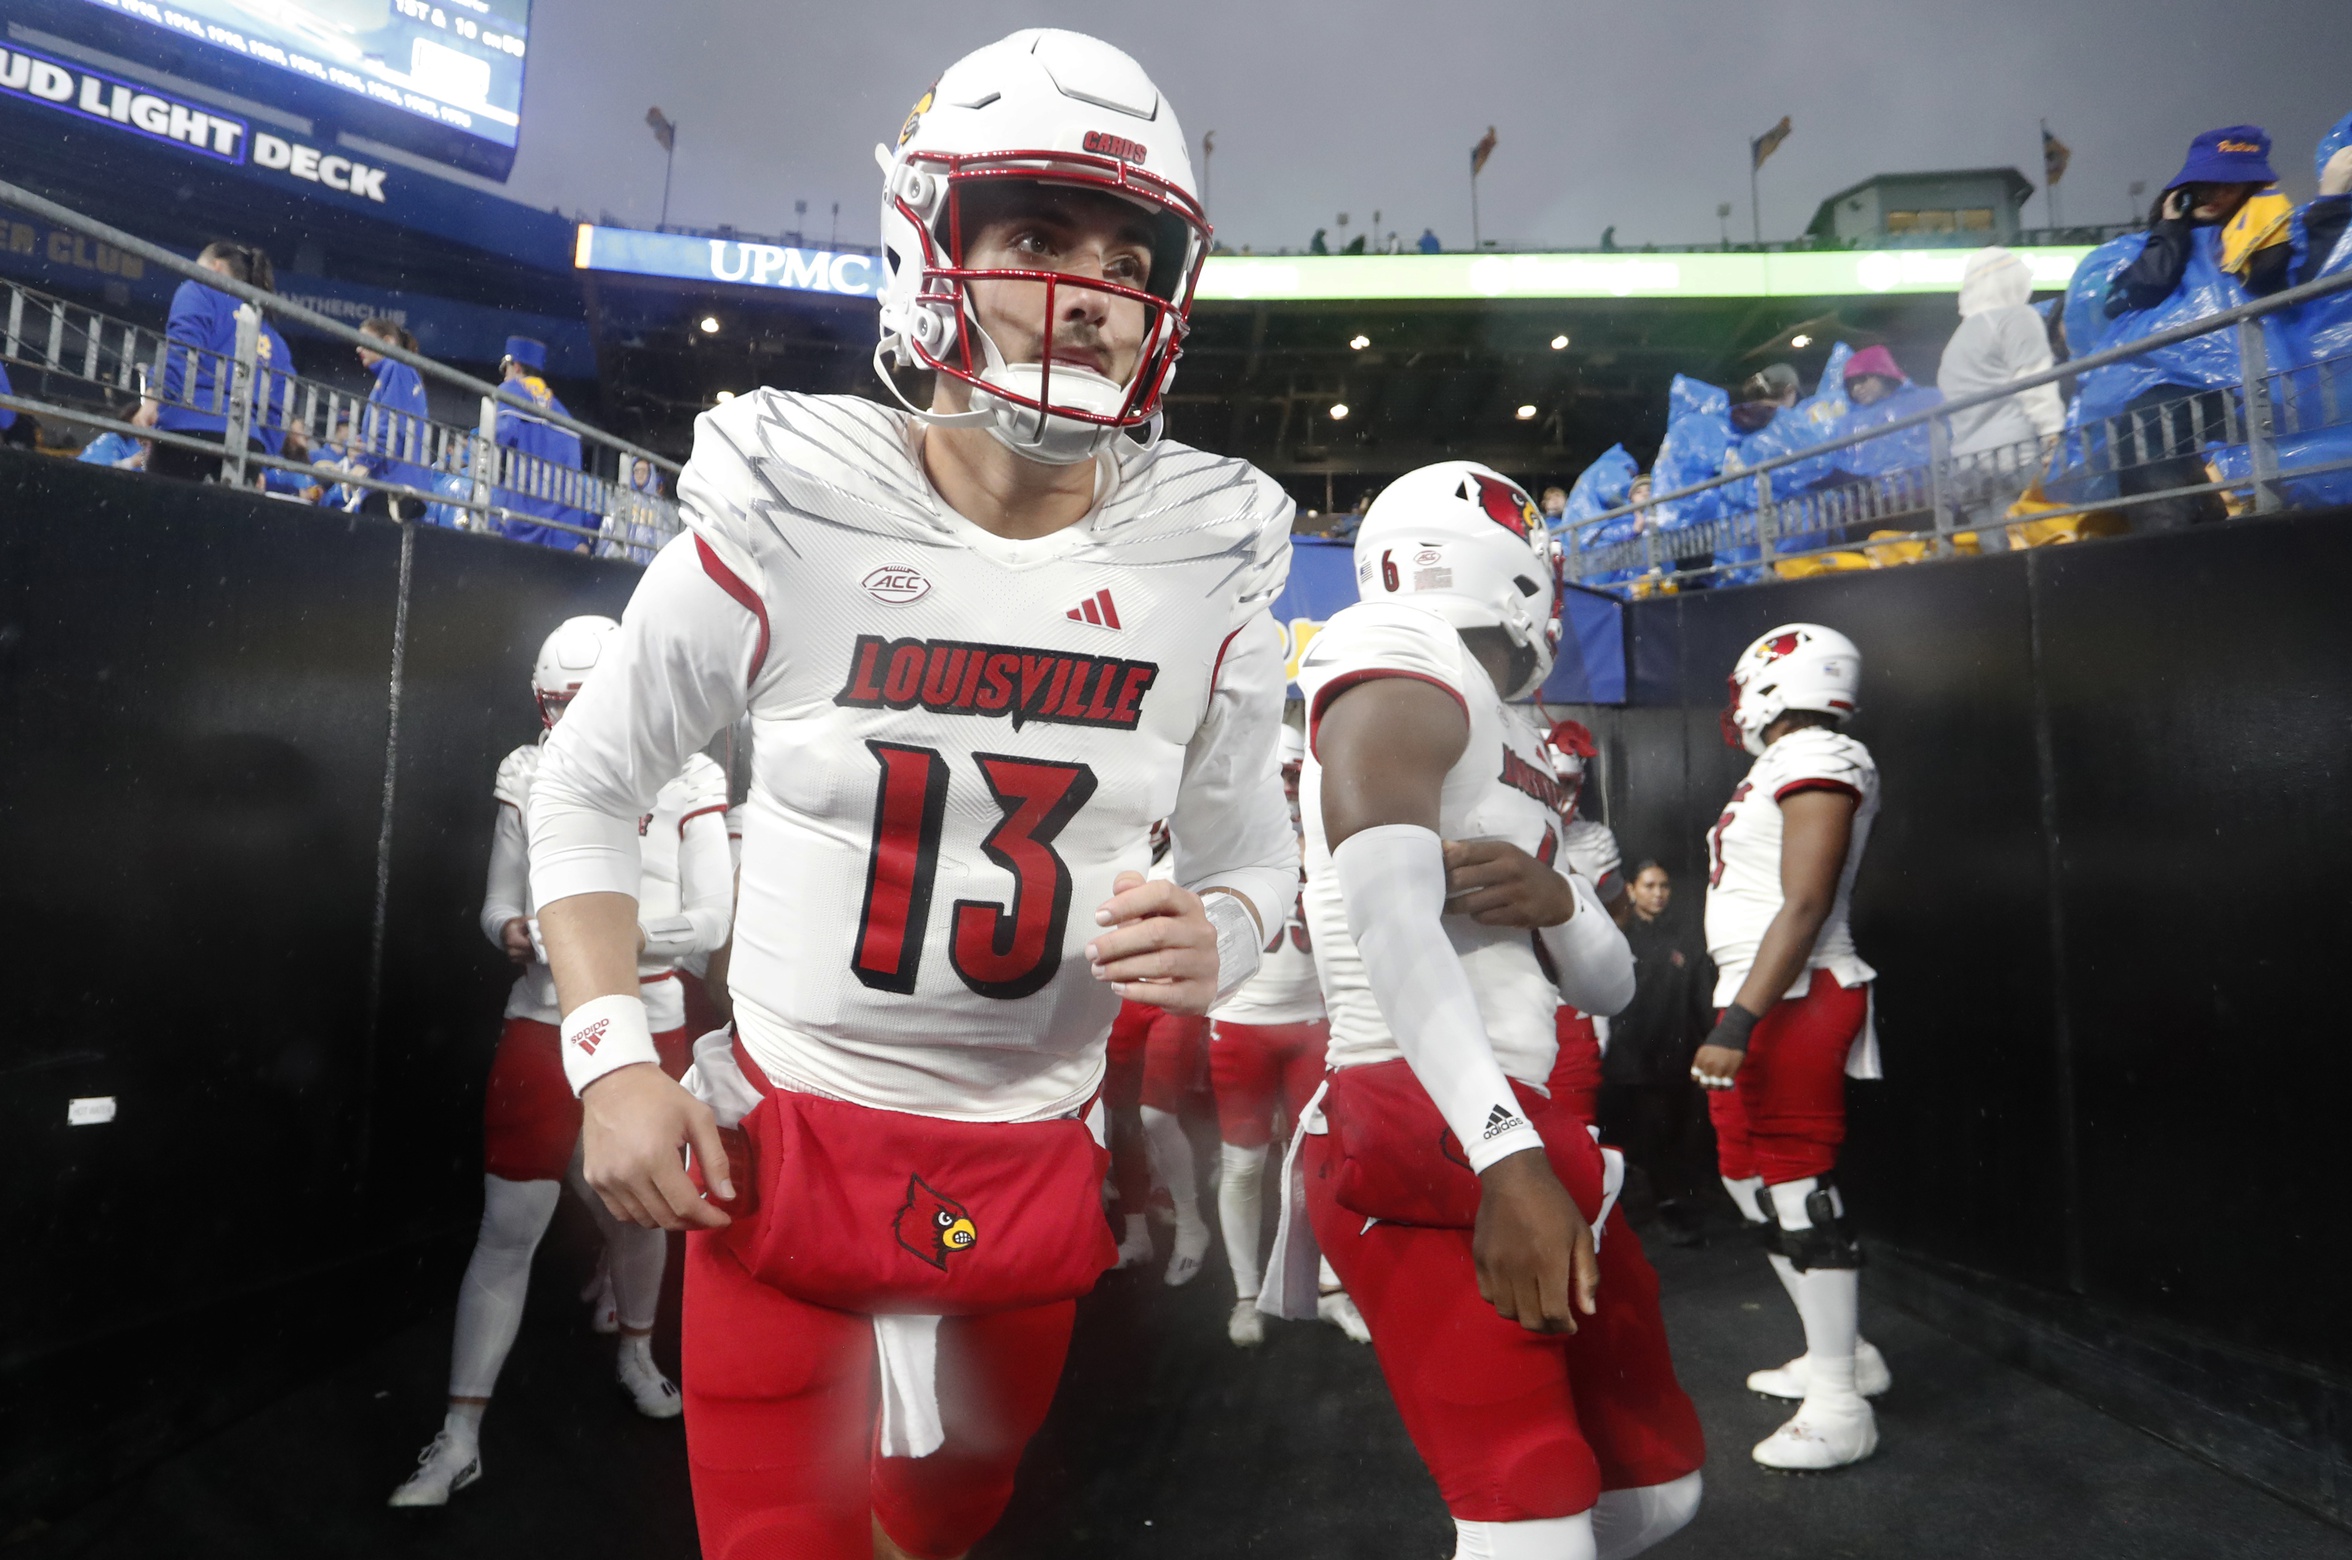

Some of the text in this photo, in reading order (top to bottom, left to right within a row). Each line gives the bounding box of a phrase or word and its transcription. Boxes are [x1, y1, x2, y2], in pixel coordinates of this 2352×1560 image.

[78, 74, 243, 156] LIGHT
[253, 132, 387, 203] DECK
[1082, 130, 1147, 165] CARDS
[47, 231, 144, 281] CLUB
[708, 239, 871, 294] UPMC
[873, 575, 921, 589] ACC
[1381, 548, 1399, 592] 6
[833, 634, 1159, 733] LOUISVILLE
[851, 739, 1098, 999] 13
[571, 1018, 610, 1044] adidas
[1483, 1117, 1523, 1140] adidas
